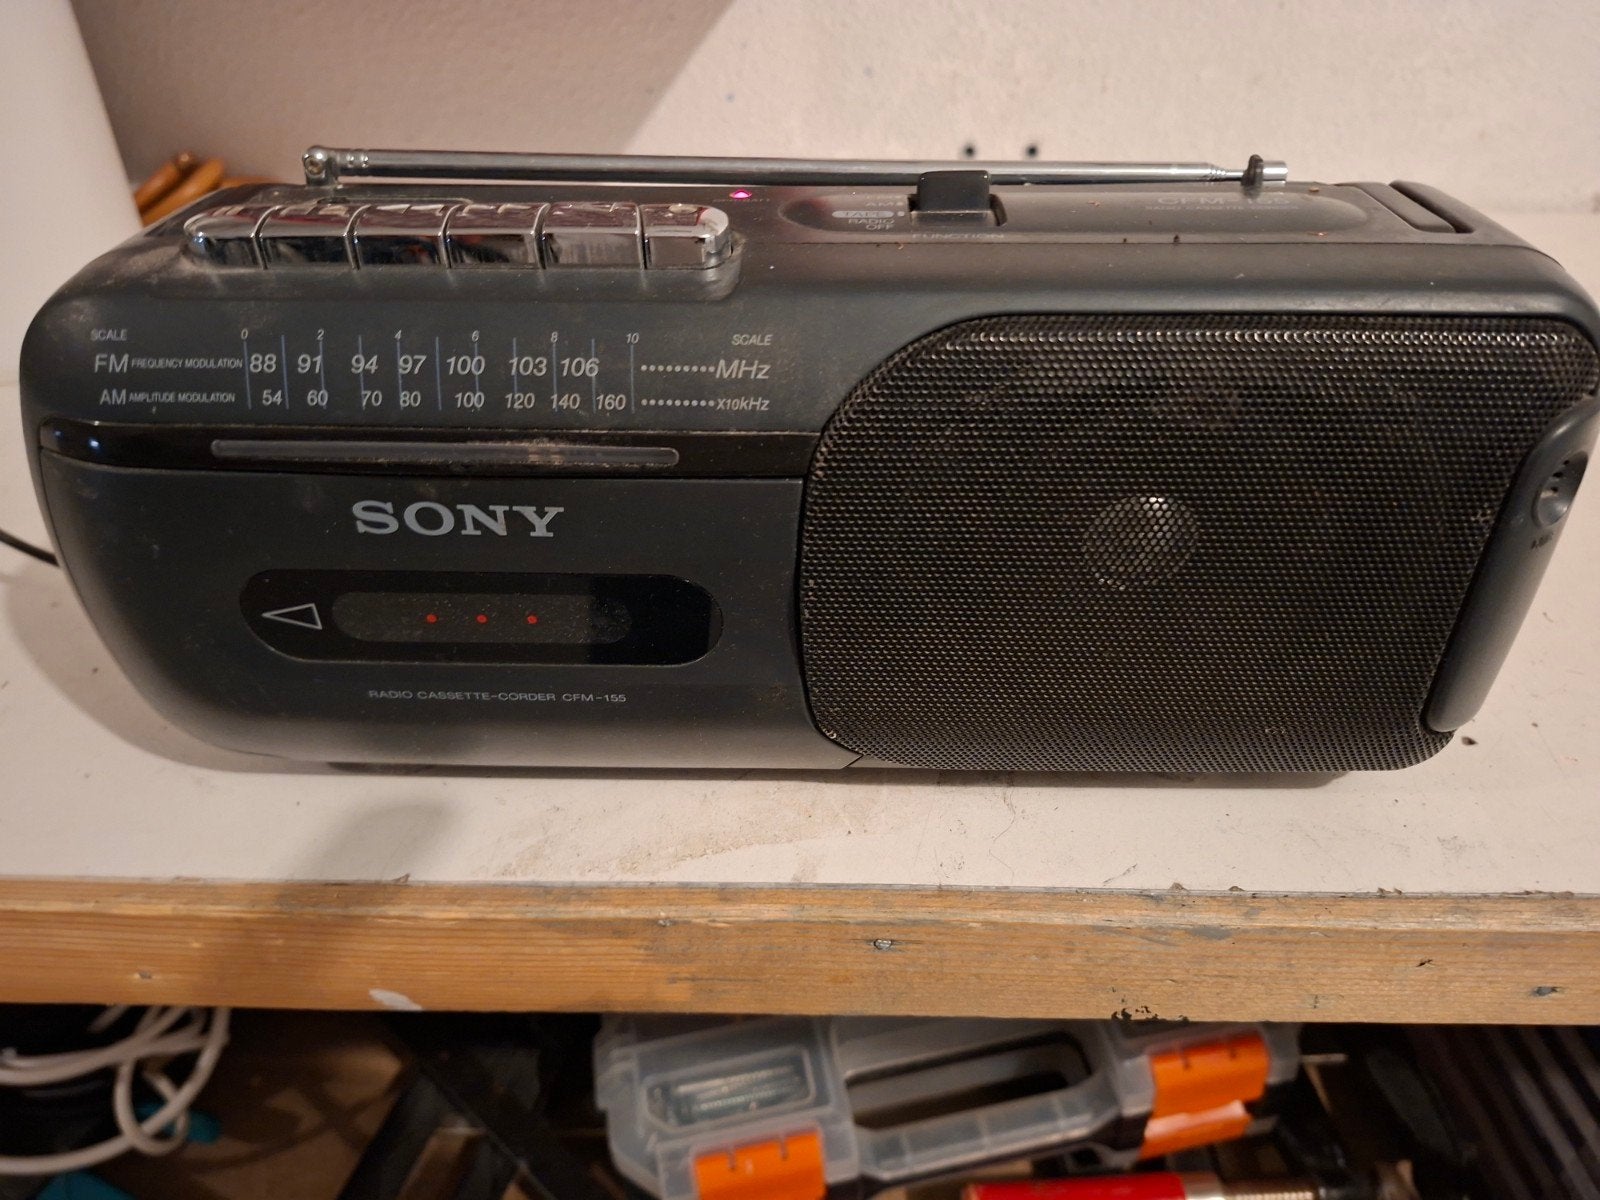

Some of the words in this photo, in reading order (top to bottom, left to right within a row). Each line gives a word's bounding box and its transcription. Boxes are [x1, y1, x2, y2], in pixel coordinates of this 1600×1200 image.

[90, 328, 128, 342] SCALE
[240, 328, 249, 340] 0
[317, 329, 325, 341] 2
[394, 329, 402, 340] 4
[471, 330, 480, 342] 6
[550, 331, 559, 343] 8
[625, 332, 640, 344] 10
[731, 333, 773, 346] SCALE
[94, 353, 130, 373] FM
[131, 358, 183, 369] FREQUENCY
[185, 358, 243, 368] MODULATION
[249, 353, 277, 373] 88
[297, 354, 323, 374] 91
[350, 354, 379, 374] 94
[398, 354, 427, 374] 97
[446, 355, 486, 376] 100
[508, 356, 548, 377] 103
[560, 356, 600, 378] 106
[715, 359, 772, 380] MHz
[100, 388, 127, 405] AM
[128, 392, 176, 403] AMPLITUDE
[178, 392, 236, 403] MODULATION
[261, 389, 284, 406] 54
[306, 390, 329, 407] 60
[360, 390, 383, 407] 70
[399, 391, 422, 408] 80
[454, 391, 486, 408] 100
[504, 392, 536, 409] 120
[550, 393, 581, 410] 140
[596, 394, 627, 411] 160
[351, 499, 565, 538] SONY
[368, 689, 413, 700] RADIO
[417, 690, 557, 702] CASSETTE-CORDER
[561, 692, 627, 703] CFM-155
